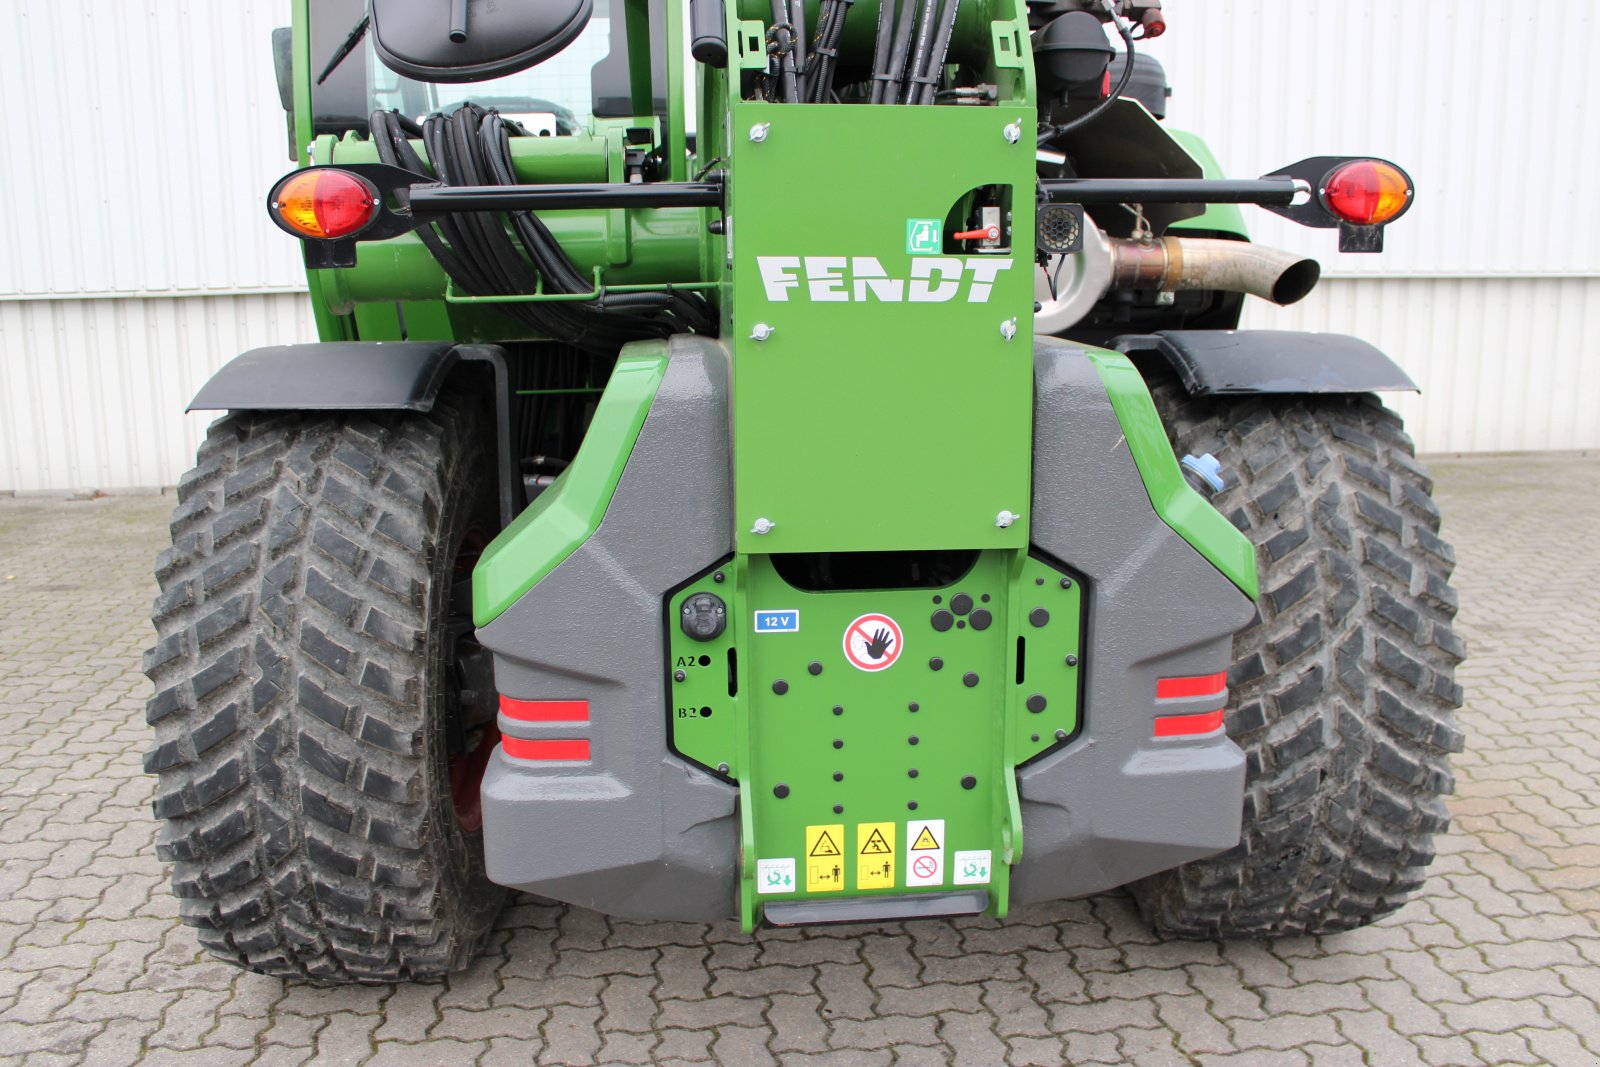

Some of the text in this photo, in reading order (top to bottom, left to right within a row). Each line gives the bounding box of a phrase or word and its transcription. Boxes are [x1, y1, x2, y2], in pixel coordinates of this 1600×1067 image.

[756, 256, 1014, 303] FENDT
[764, 616, 790, 627] 12 V
[677, 656, 696, 667] A2
[678, 707, 697, 719] B2
